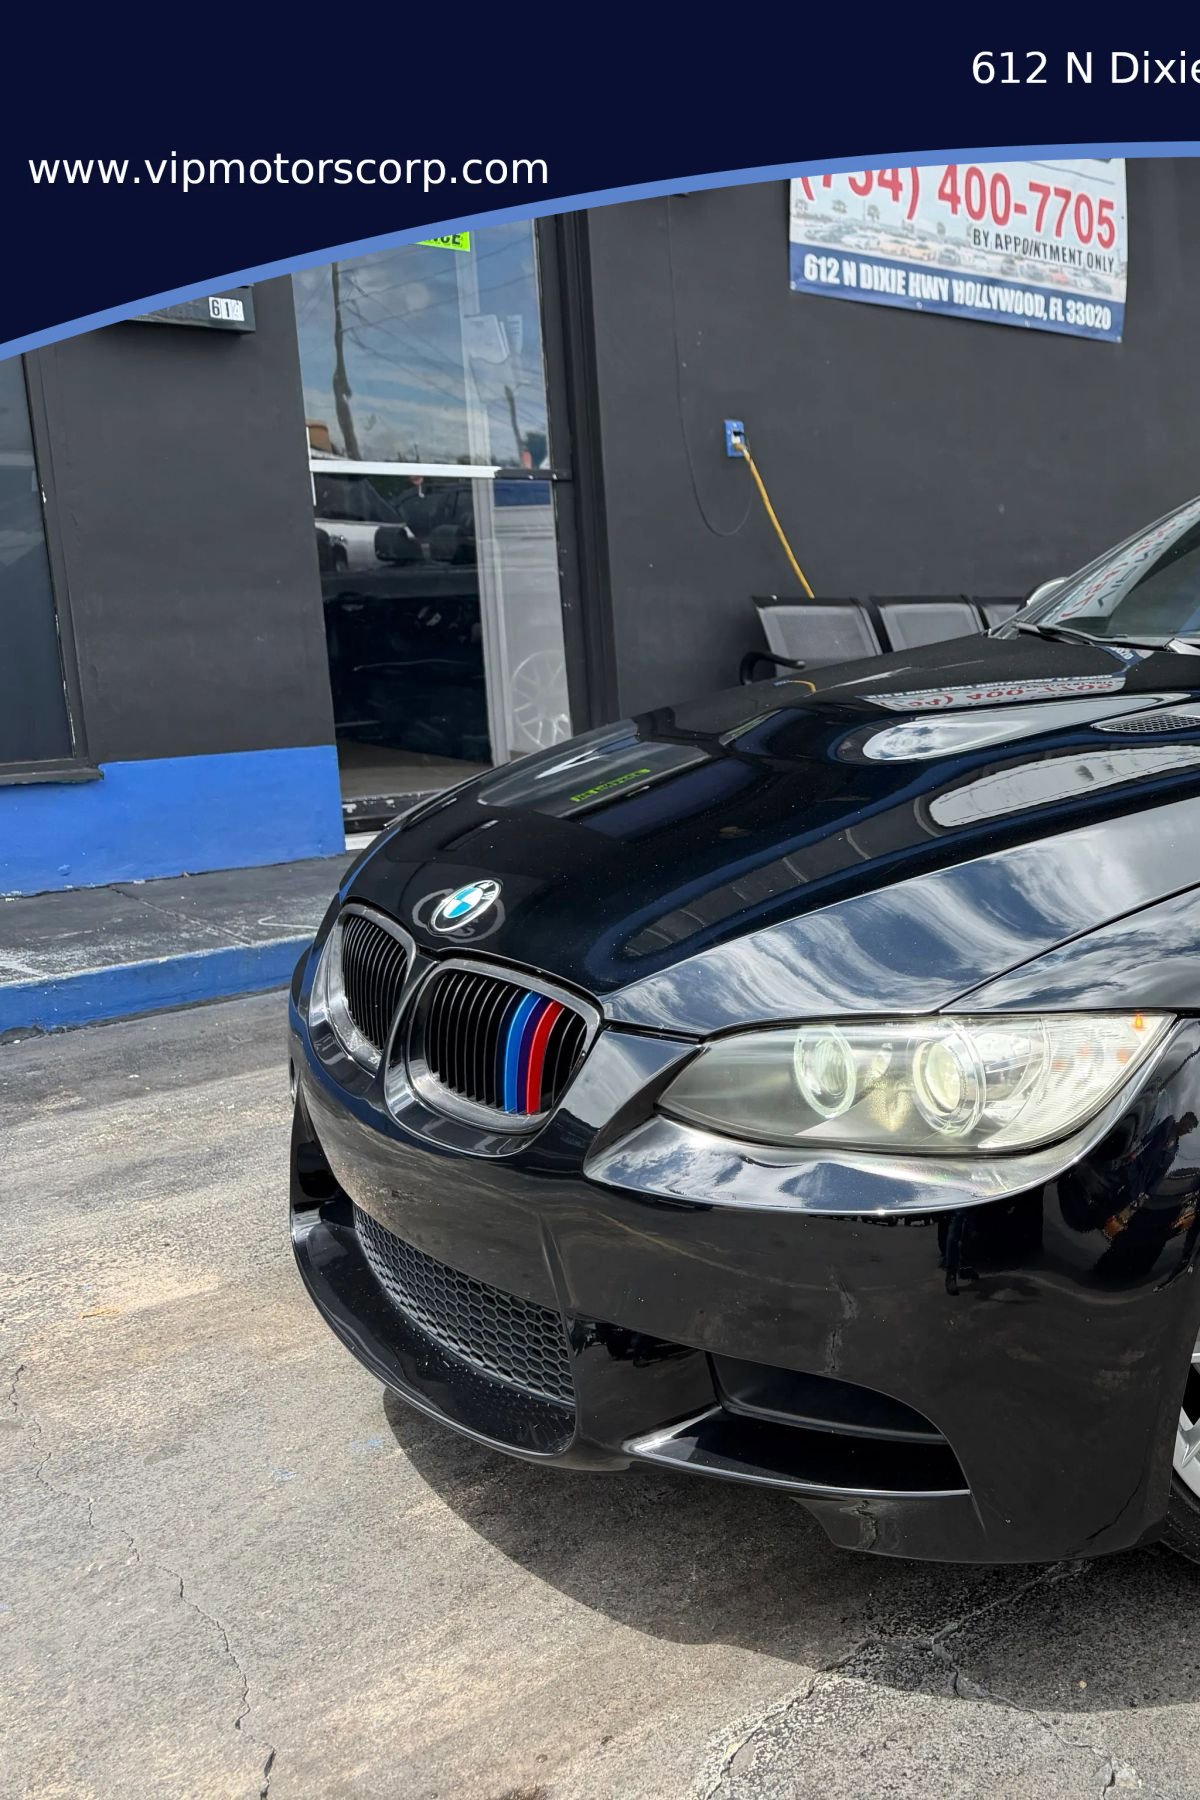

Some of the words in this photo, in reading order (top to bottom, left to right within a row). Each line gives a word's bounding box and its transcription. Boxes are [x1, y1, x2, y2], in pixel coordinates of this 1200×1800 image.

[937, 163, 1116, 249] 400-7705
[973, 228, 990, 247] BY
[994, 234, 1082, 266] APPOINTMENT
[1086, 252, 1115, 273] ONLY
[211, 299, 241, 319] 61
[804, 253, 840, 284] 612
[842, 259, 857, 288] N
[859, 263, 907, 295] DIXIE
[908, 271, 950, 302] HWY
[951, 279, 1048, 321] HOLLYWOOD,
[1049, 295, 1065, 322] FL
[1065, 300, 1113, 330] 33020
